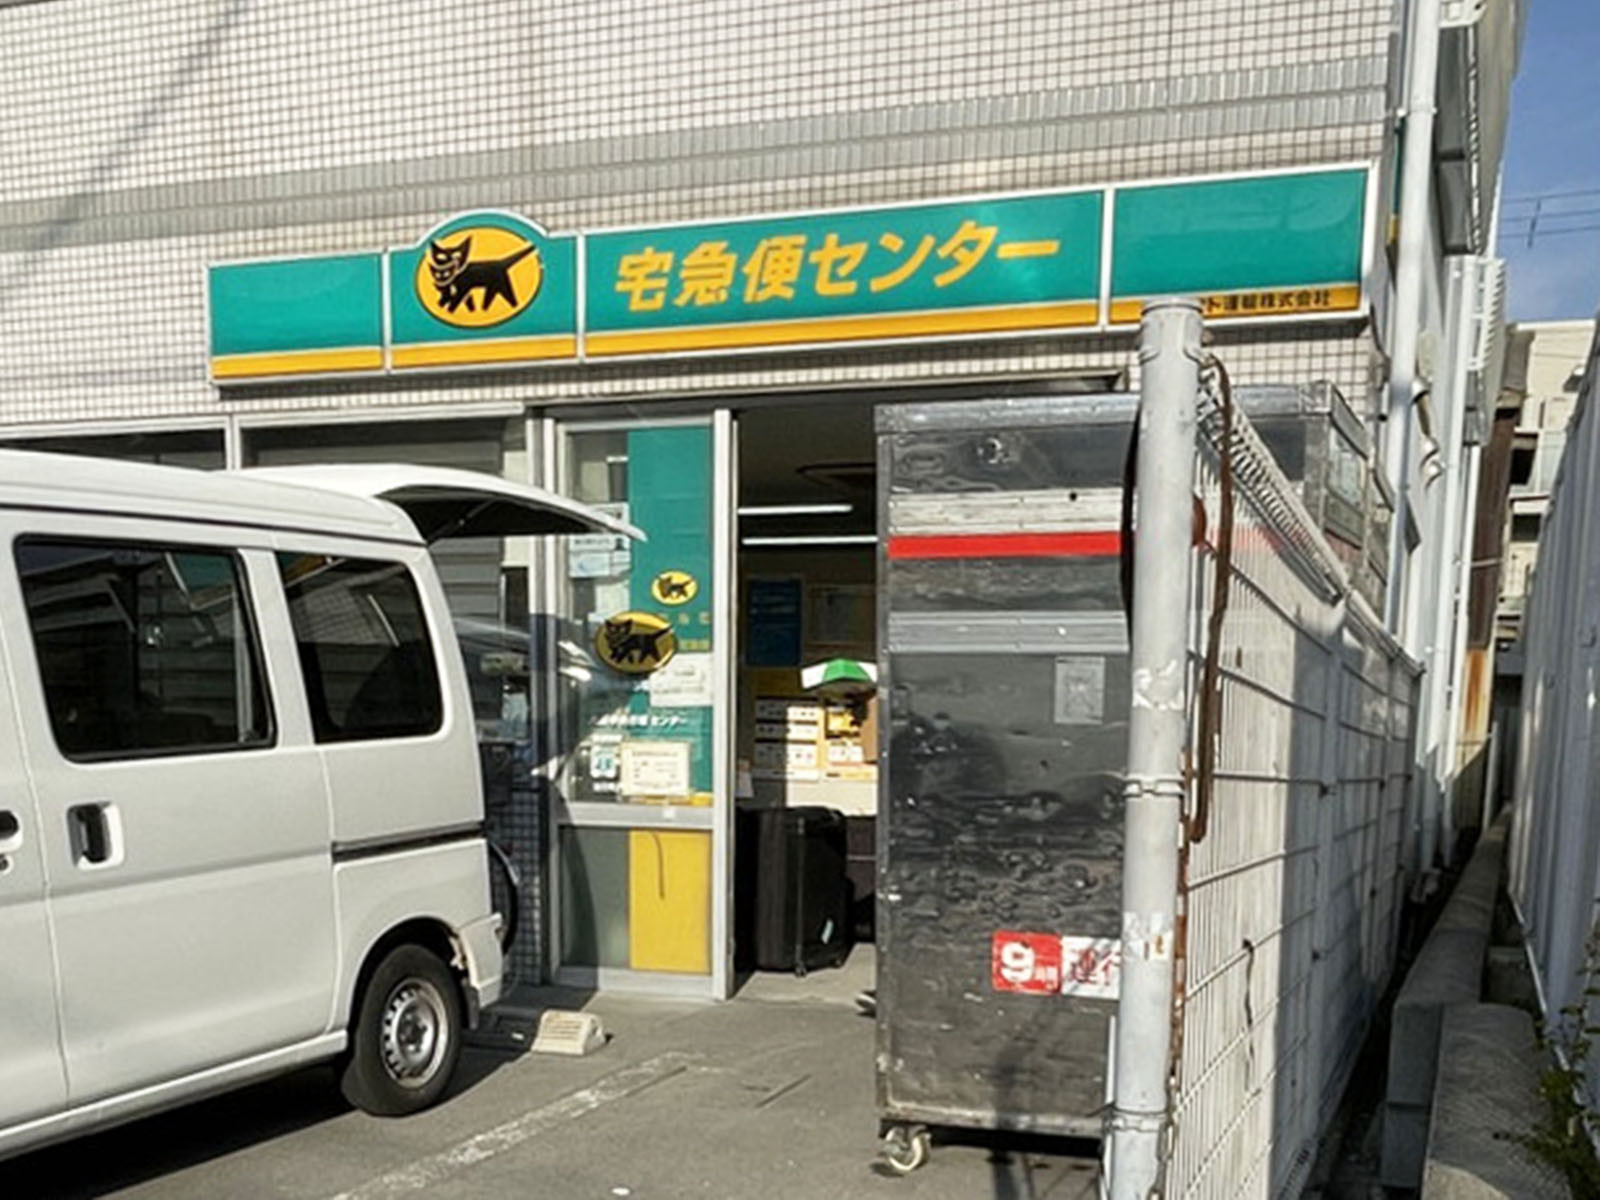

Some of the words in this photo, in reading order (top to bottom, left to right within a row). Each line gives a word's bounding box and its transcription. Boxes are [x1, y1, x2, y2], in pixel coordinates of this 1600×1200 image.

[615, 220, 1061, 312] 宅急便センター
[1200, 290, 1331, 312] ト運輸株式会社
